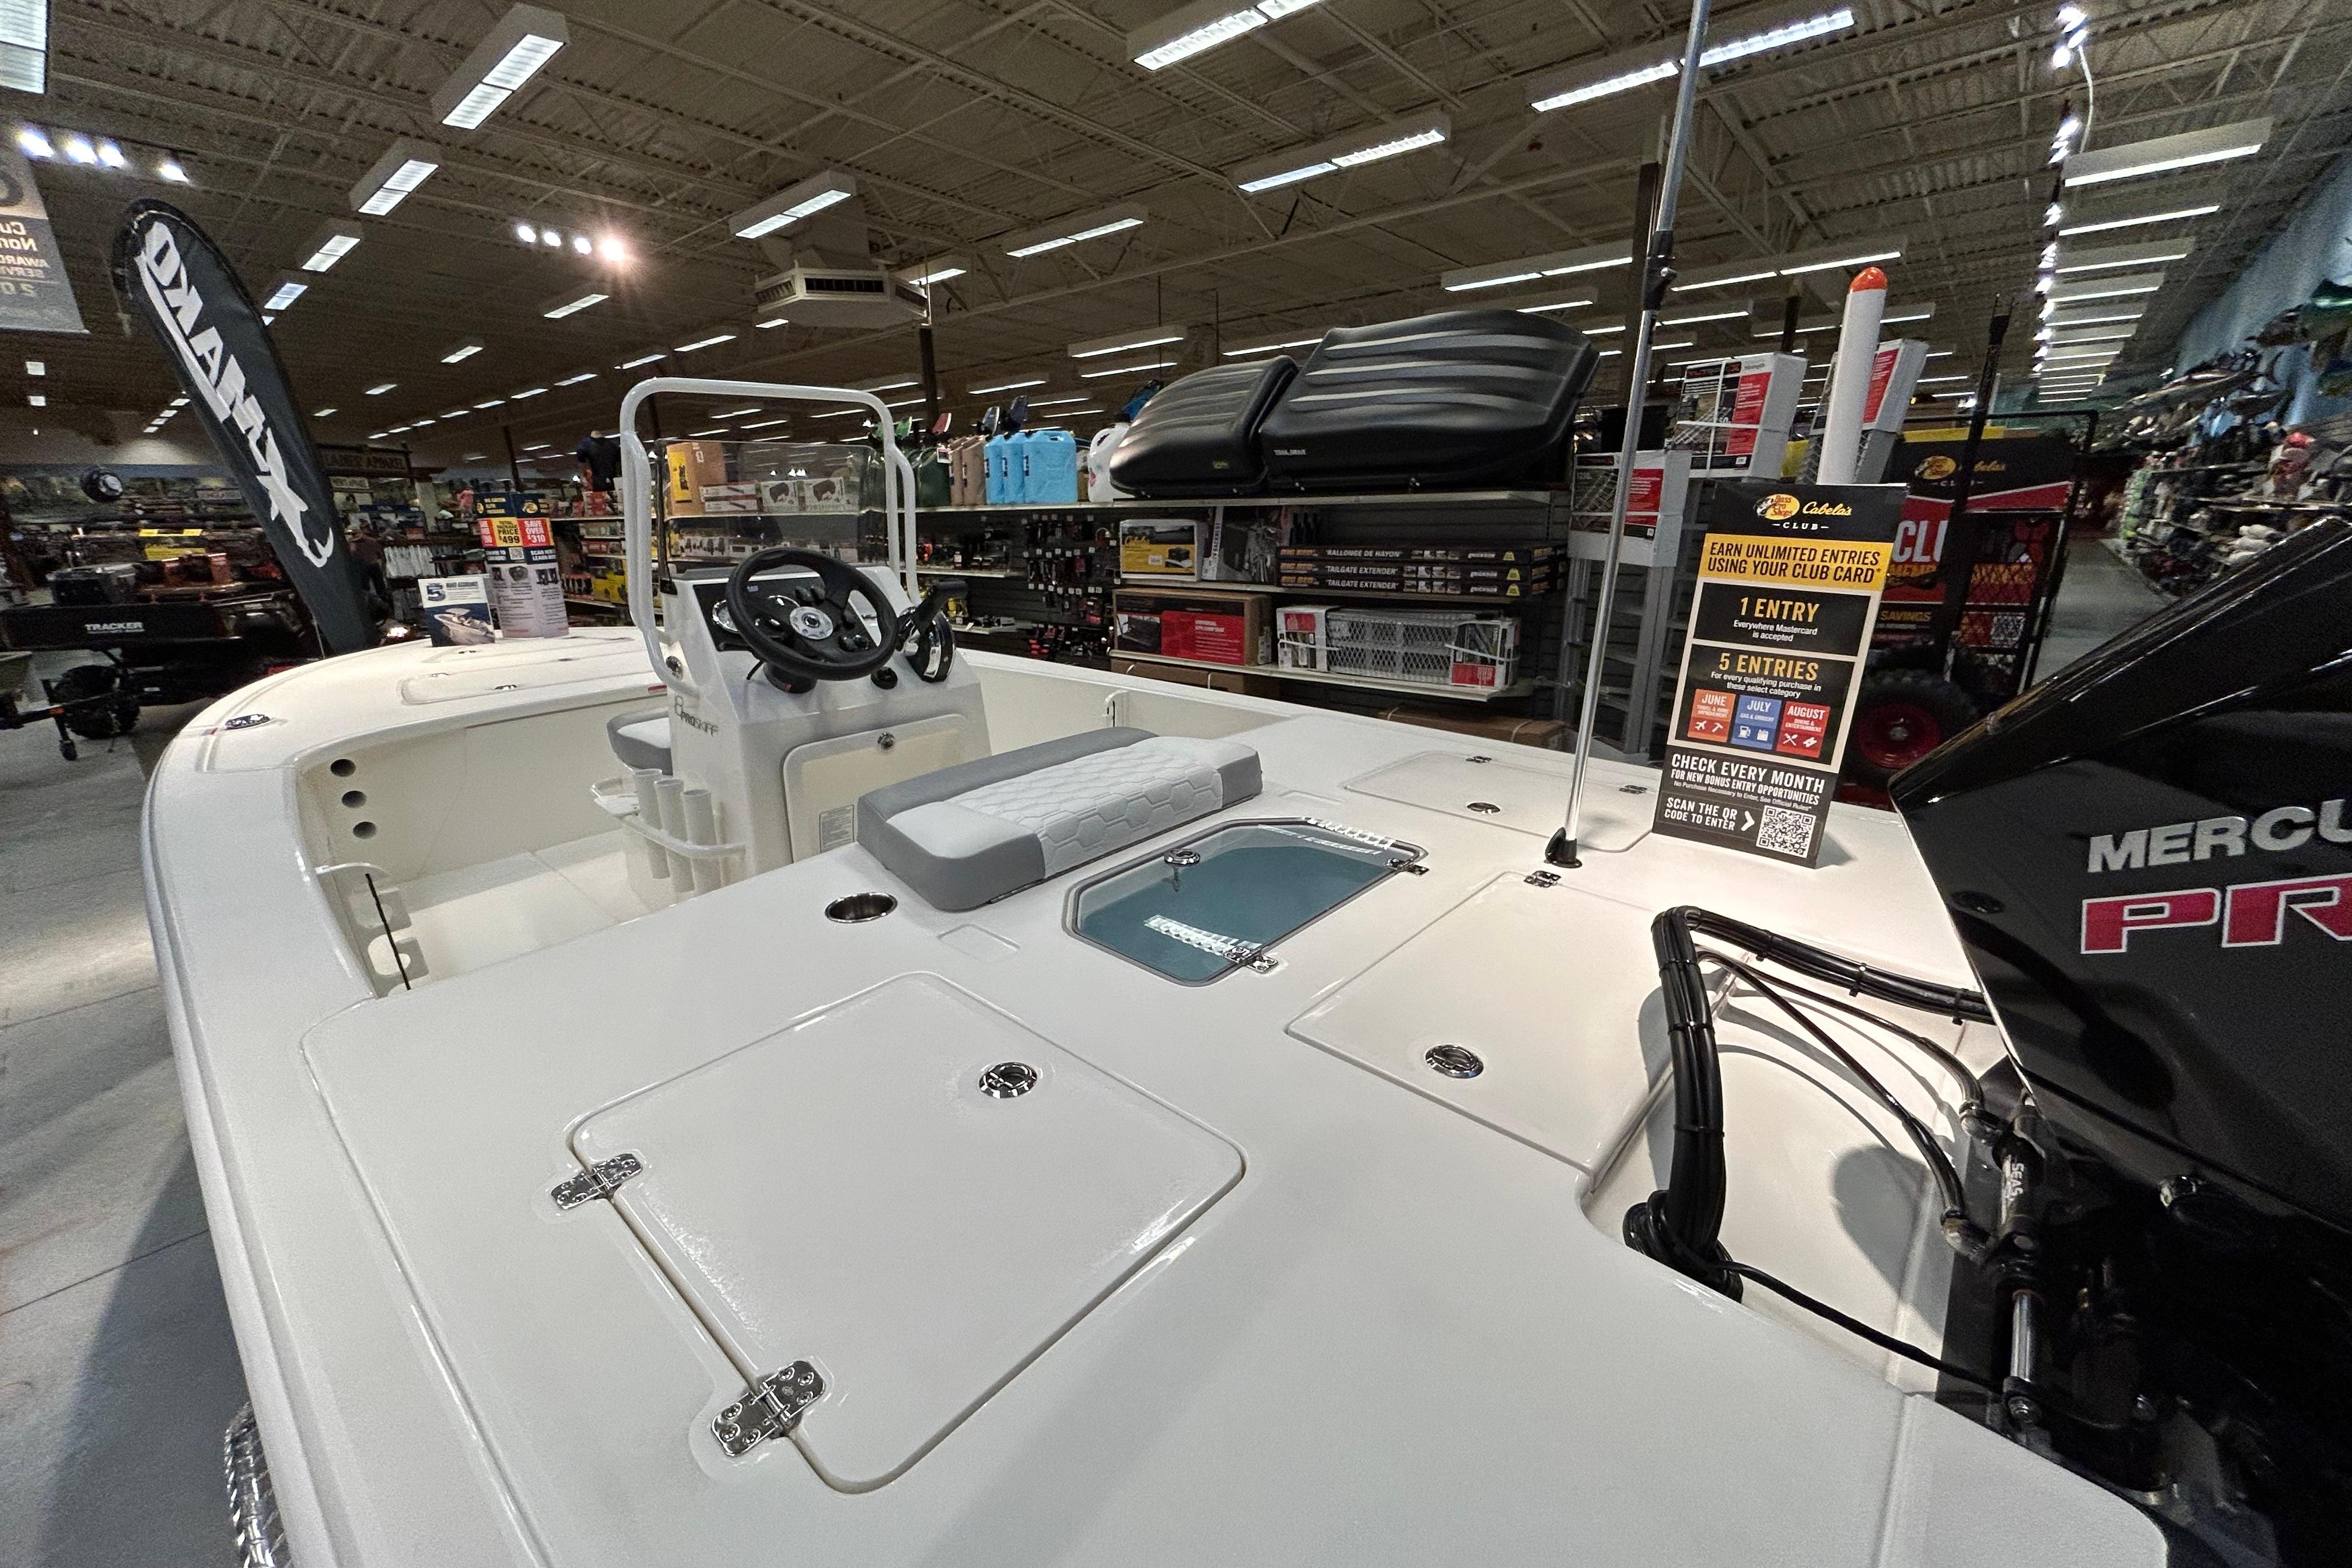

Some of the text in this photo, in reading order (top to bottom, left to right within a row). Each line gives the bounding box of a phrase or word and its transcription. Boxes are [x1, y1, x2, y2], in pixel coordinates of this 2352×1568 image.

[1802, 501, 1853, 516] Cabela's
[1783, 522, 1819, 530] CLUB
[1710, 542, 1881, 566] EARN UNLIMITED ENTRIES
[1708, 557, 1748, 573] USING
[1752, 560, 1788, 577] YOUR
[1792, 563, 1829, 580] CLUB
[1741, 597, 1820, 622] 1 ENTRY
[84, 622, 144, 631] TRACKER
[1733, 620, 1818, 635] Everywhere Mastercard
[1760, 632, 1794, 642] accepted
[1718, 652, 1819, 681] 5 ENTRIES
[1723, 673, 1742, 682] every
[1743, 676, 1777, 687] qualifying
[1779, 680, 1812, 691] purchase
[1814, 684, 1822, 692] in
[1727, 681, 1801, 699] these select category
[1702, 694, 1727, 706] JUNE
[1747, 700, 1772, 712] JULY
[1787, 705, 1826, 720] AUGUST
[1671, 753, 1825, 794] CHECK EVERY MONTH
[1671, 769, 1820, 806] FOR NEW BONUS ENTRY OPPORTUNITIES
[1682, 782, 1707, 791] Purchase
[1707, 786, 1736, 797] Necessary
[1772, 799, 1792, 807] Official
[1667, 797, 1738, 820] SCAN THE QR
[1664, 808, 1735, 831] CODE TO ENTER
